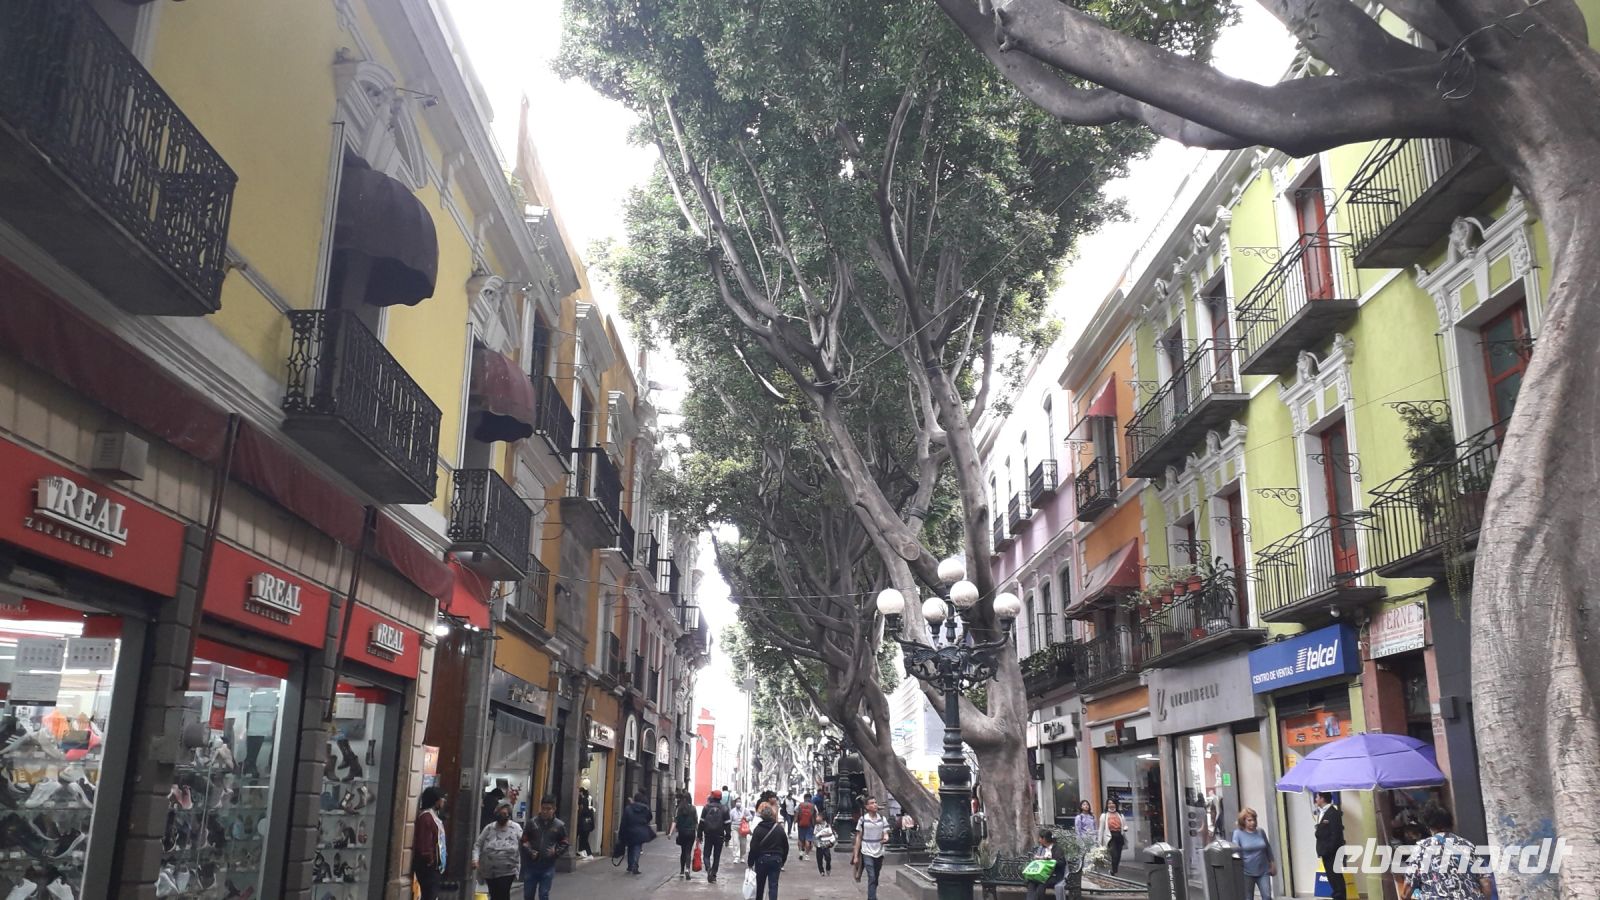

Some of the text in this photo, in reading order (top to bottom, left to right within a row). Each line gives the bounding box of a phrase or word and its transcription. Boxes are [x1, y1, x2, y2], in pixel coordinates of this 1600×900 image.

[55, 477, 128, 540] REAL
[263, 573, 302, 611] REAL
[380, 623, 404, 652] REAL
[1307, 639, 1338, 671] telcel
[1253, 666, 1294, 684] CENTRO DE VENTAS
